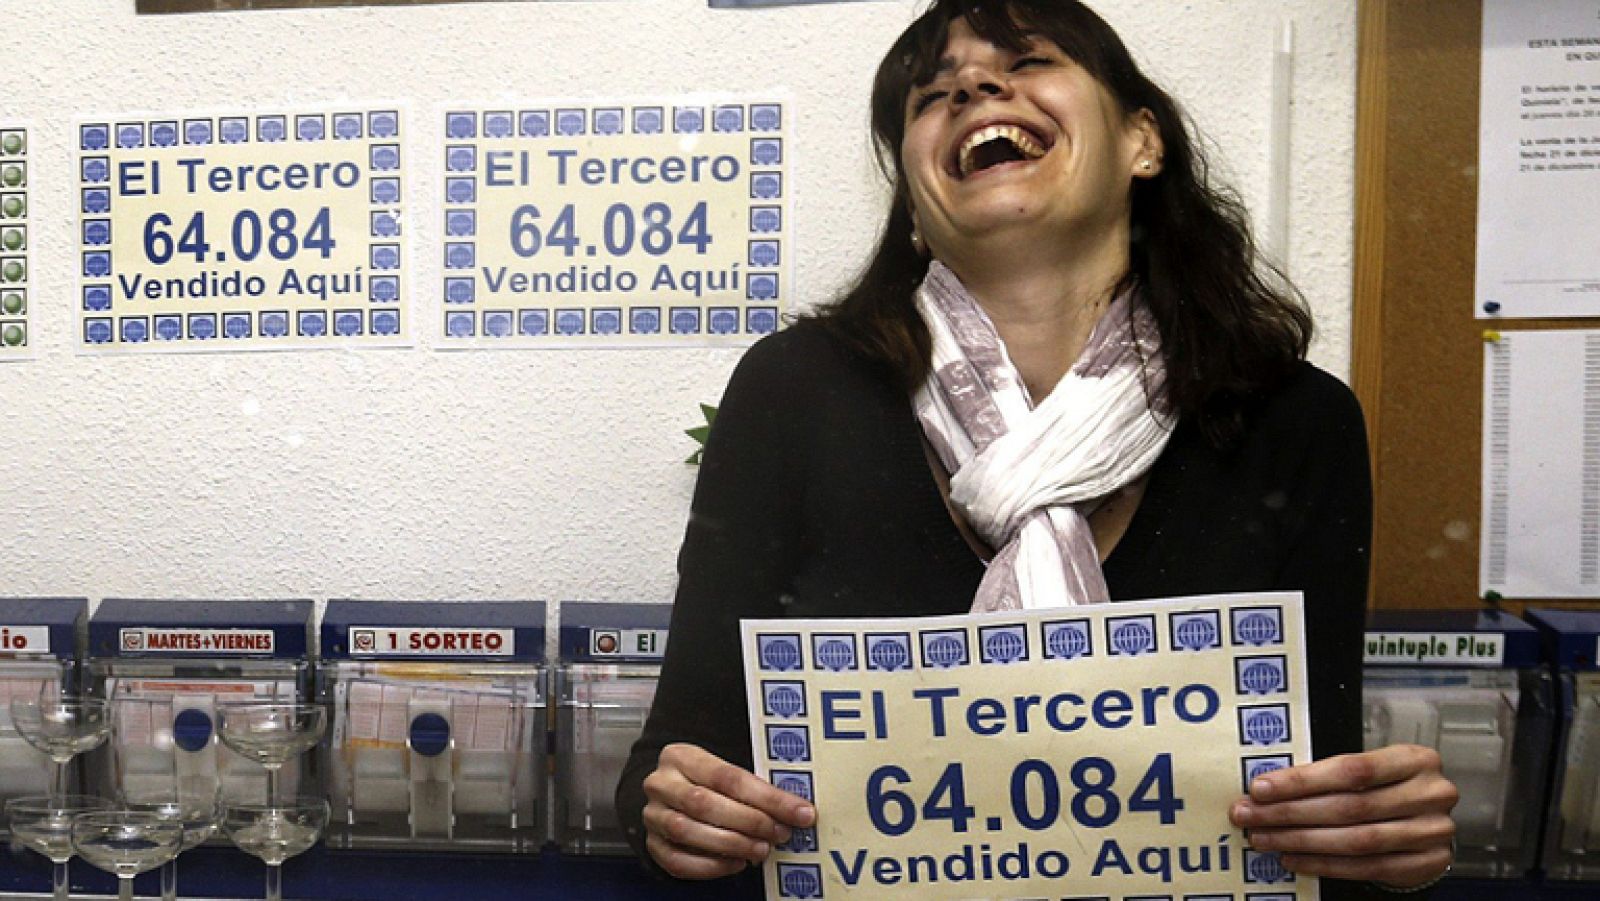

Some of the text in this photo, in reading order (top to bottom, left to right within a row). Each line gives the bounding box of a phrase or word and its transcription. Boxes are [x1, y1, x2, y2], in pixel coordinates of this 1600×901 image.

[119, 159, 360, 196] El Tercero
[485, 150, 740, 187] El Tercero
[143, 207, 336, 266] 64.084
[510, 202, 713, 258] 64.084
[119, 267, 362, 301] Vendido Aquí
[482, 263, 740, 297] Vendido Aquí
[388, 632, 503, 650] 1 SORTEO
[637, 631, 657, 652] El
[1456, 635, 1497, 657] Plus
[821, 684, 1220, 740] El Tercero
[866, 753, 1185, 837] 64.084
[829, 834, 1232, 886] Vendido Aquí
